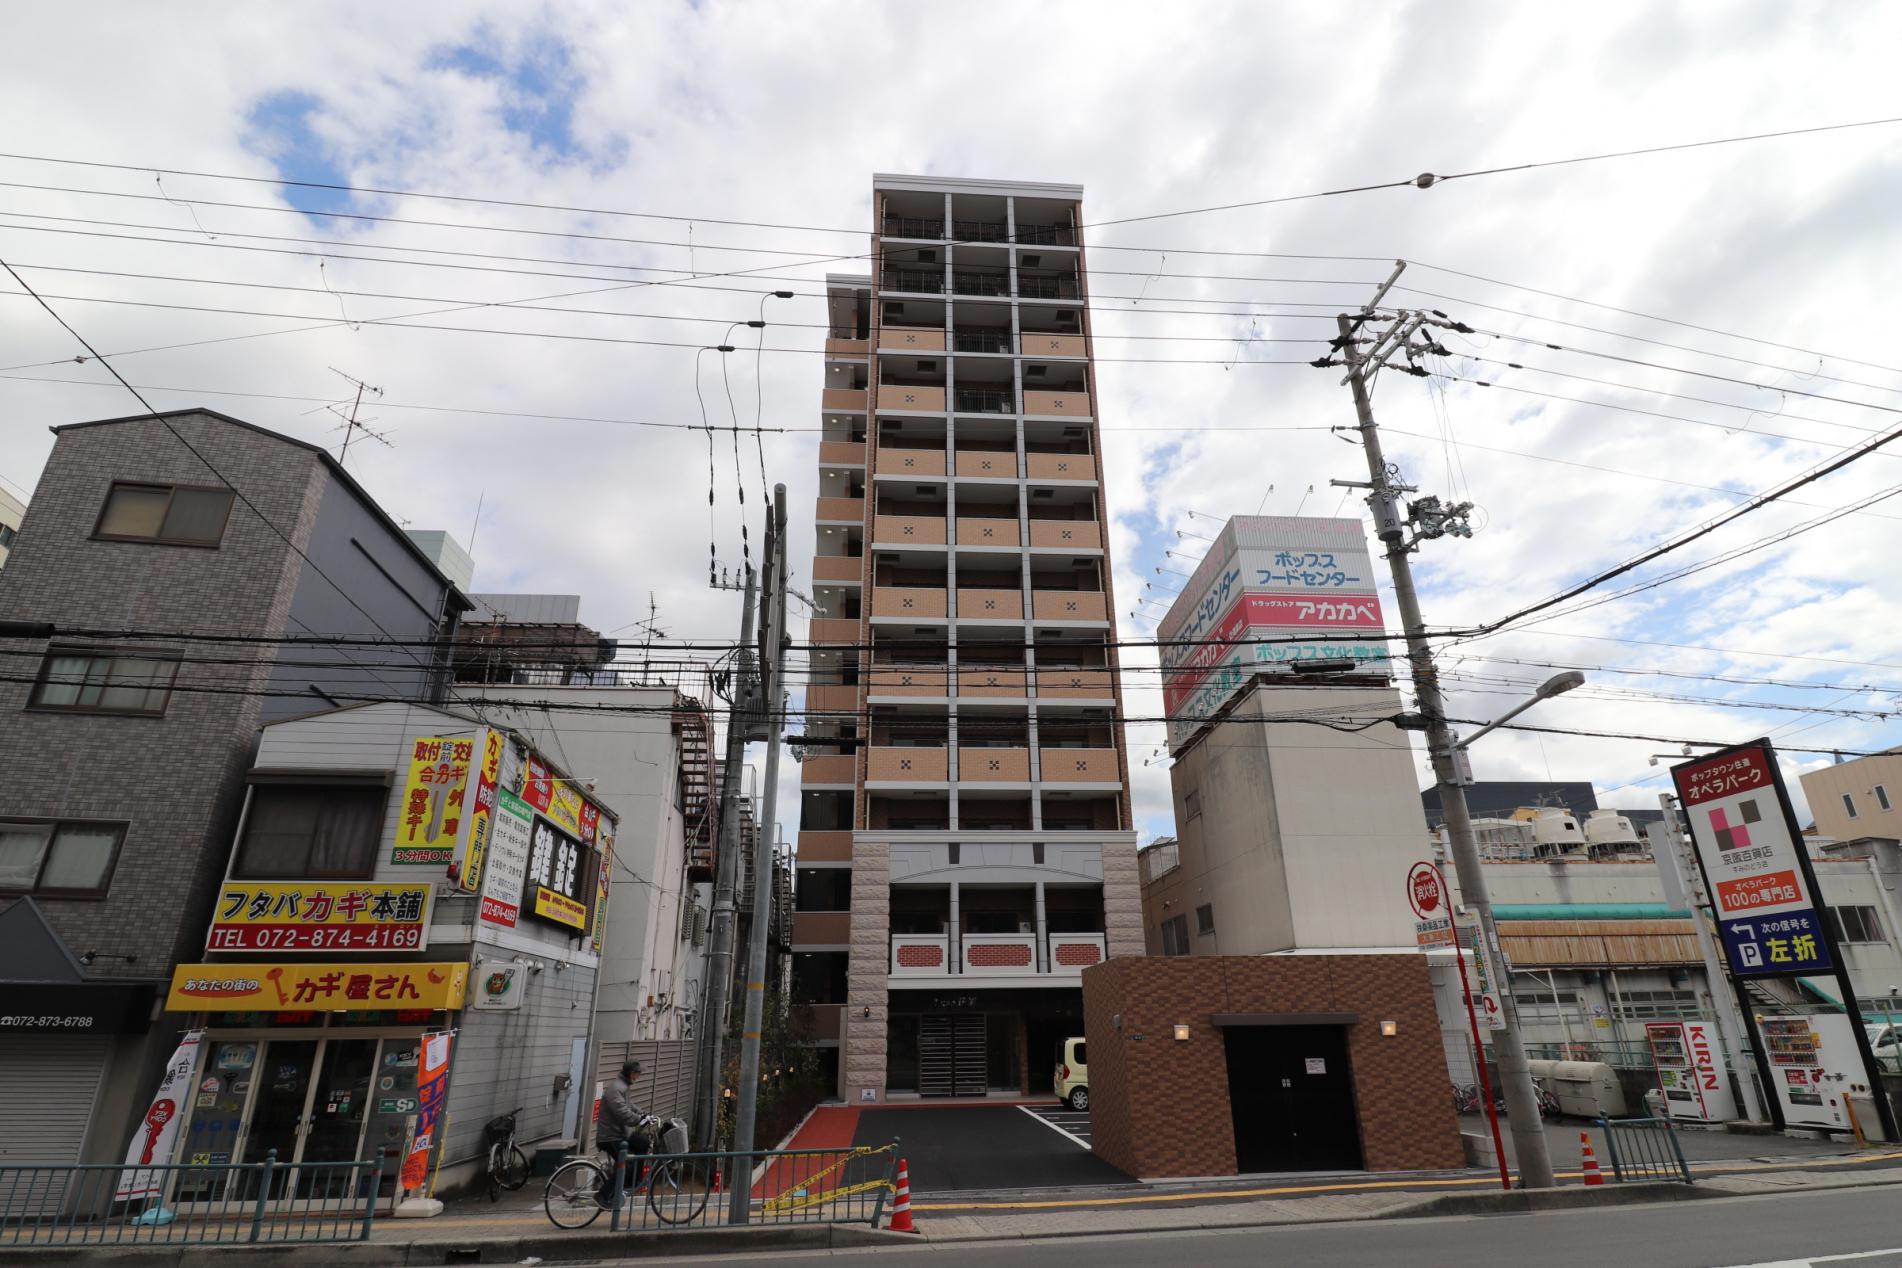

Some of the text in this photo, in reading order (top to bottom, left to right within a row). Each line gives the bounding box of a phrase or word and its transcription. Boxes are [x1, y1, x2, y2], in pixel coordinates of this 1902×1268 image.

[1256, 569, 1360, 586] フードセンター
[1296, 601, 1376, 621] アカカベ
[414, 741, 441, 762] 取付
[487, 735, 498, 778] カギ
[1689, 768, 1761, 799] オペラパーク
[1721, 845, 1774, 865] 京阪百貨店
[1416, 882, 1438, 901] 消火栓
[1735, 877, 1776, 890] オペラパーク
[222, 889, 424, 922] フタバカギ本舗
[1724, 885, 1796, 907] 100の専門店
[1761, 918, 1810, 933] 次の信号を
[214, 929, 419, 947] TEL 072-874-4169
[1766, 934, 1817, 962] 左折
[1743, 945, 1756, 964] P
[184, 979, 259, 991] あなたの街の
[293, 972, 420, 1003] カギ屋さん
[12, 1016, 93, 1027] 072-873-6788
[1689, 1026, 1719, 1091] KIRIN
